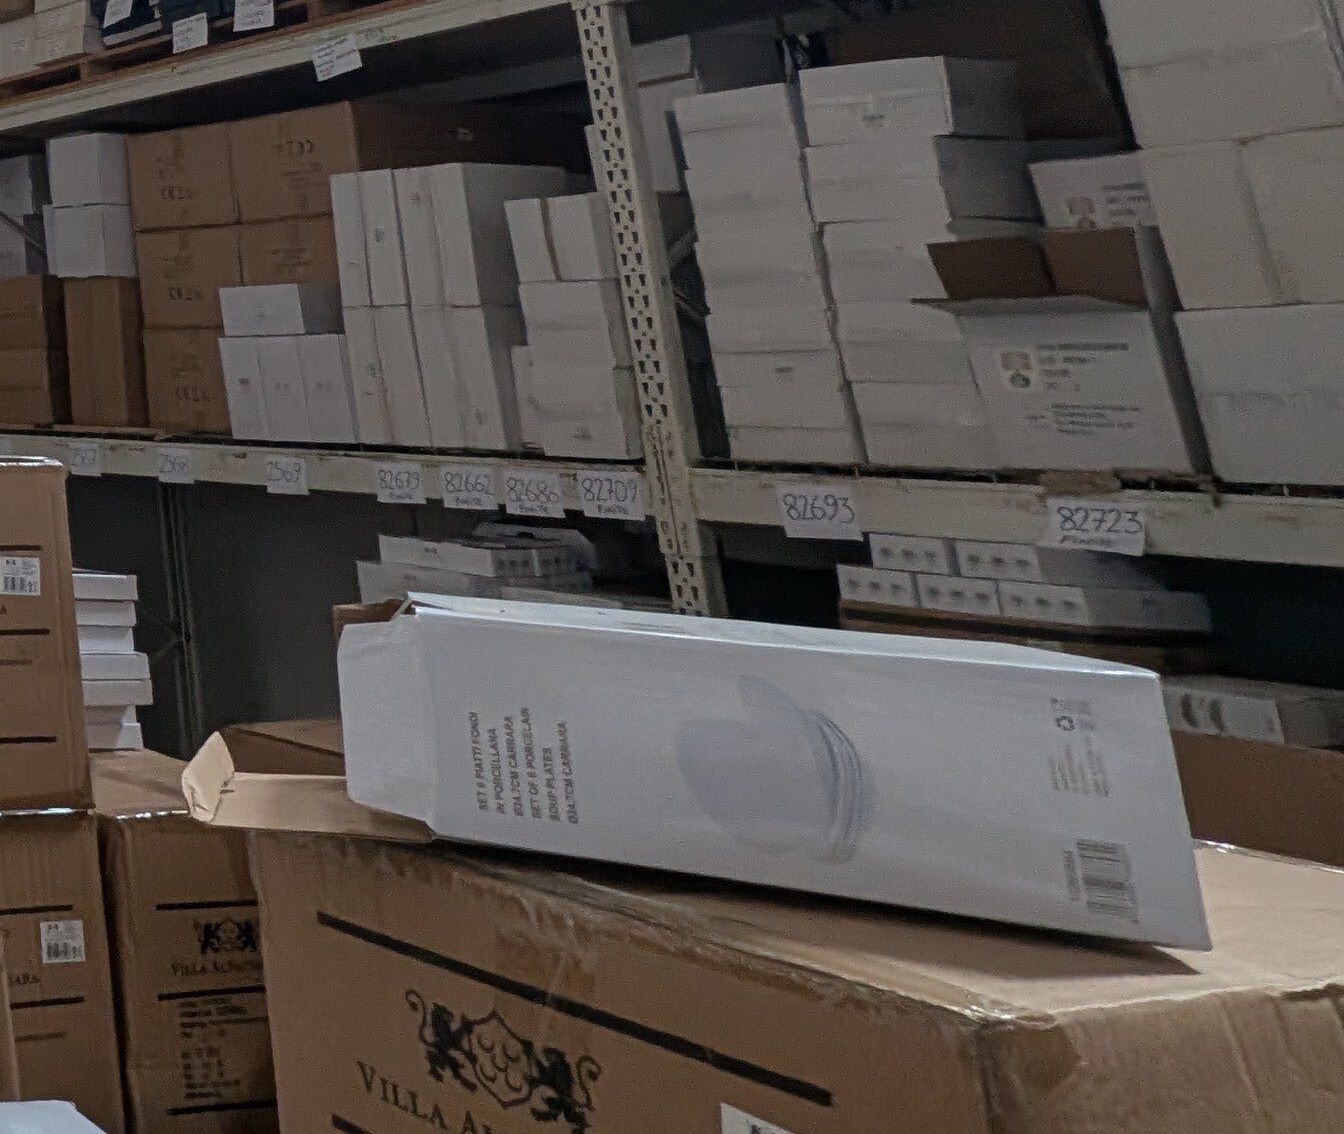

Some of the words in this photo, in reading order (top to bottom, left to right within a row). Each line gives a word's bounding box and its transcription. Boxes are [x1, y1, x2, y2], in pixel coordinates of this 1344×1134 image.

[443, 471, 494, 496] 82662
[581, 476, 638, 503] 82709
[782, 492, 856, 524] 82693
[1056, 505, 1144, 535] 82723
[503, 716, 517, 769] CARRARA
[471, 745, 485, 780] PIATTI
[486, 728, 504, 801] PORCELLANA
[356, 1059, 450, 1132] VILLA
